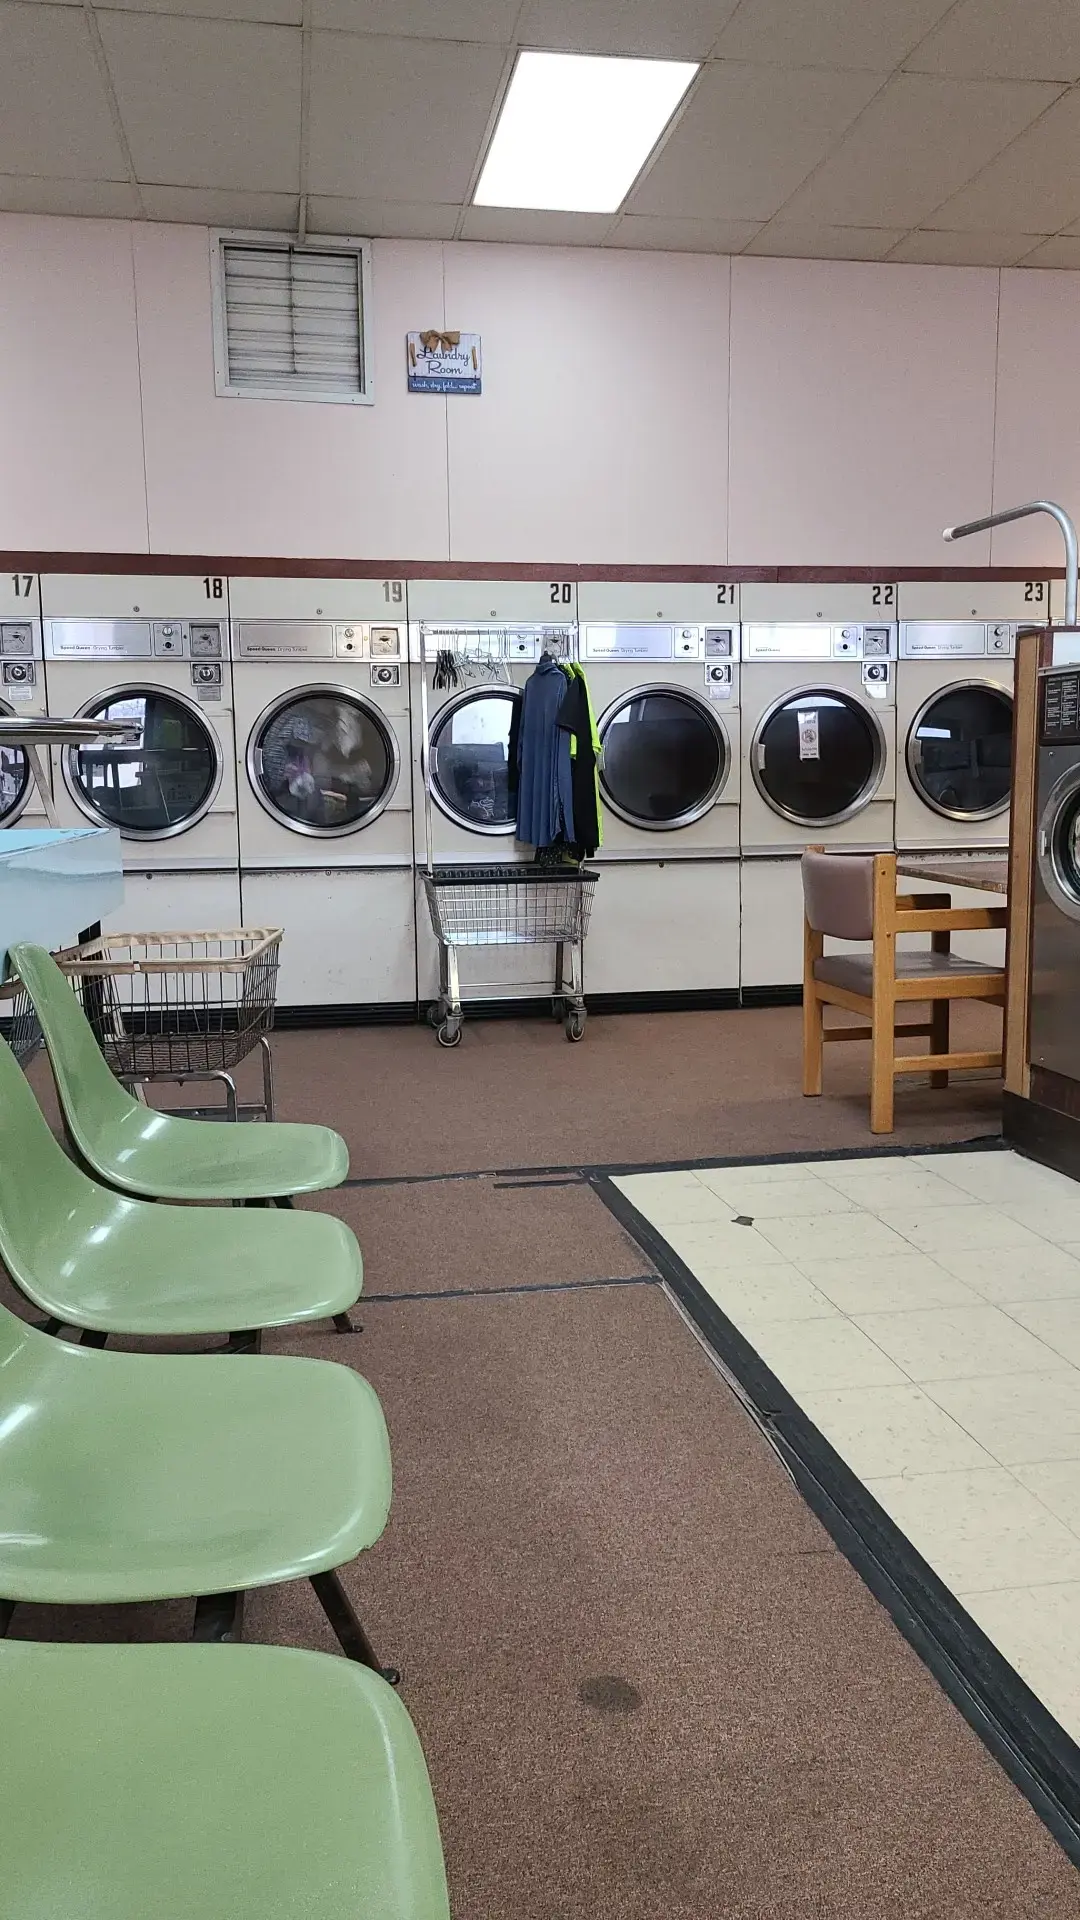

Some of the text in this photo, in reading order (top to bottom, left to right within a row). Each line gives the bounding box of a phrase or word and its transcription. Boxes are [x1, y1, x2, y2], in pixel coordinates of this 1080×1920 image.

[416, 345, 470, 366] Laundry
[425, 359, 463, 375] Room
[459, 383, 477, 391] repeat
[11, 574, 34, 597] 17
[202, 578, 223, 599] 18
[382, 581, 403, 603] 19
[550, 583, 571, 604] 20
[717, 584, 735, 605] 21
[872, 585, 894, 605] 22
[1024, 582, 1044, 602] 23
